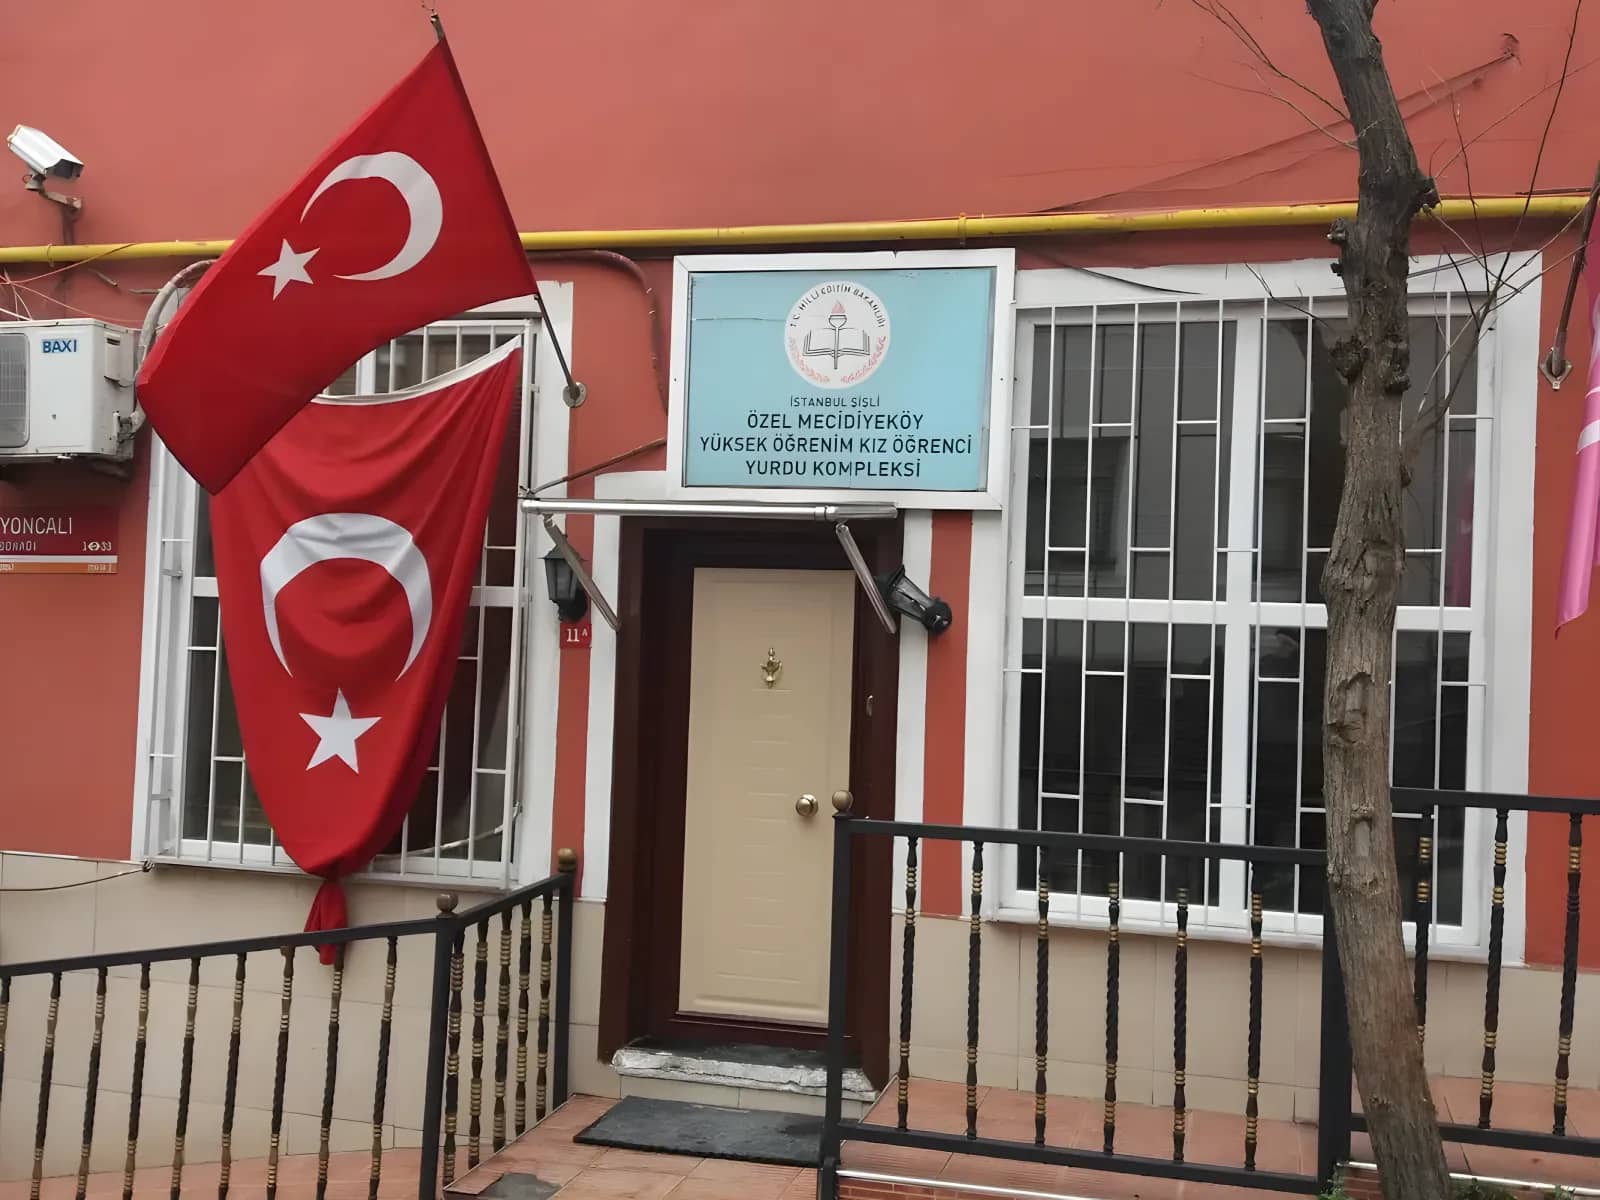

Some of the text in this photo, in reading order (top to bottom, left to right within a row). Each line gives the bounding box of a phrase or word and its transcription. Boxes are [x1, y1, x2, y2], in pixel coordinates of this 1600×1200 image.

[42, 339, 77, 353] BAXI
[790, 396, 848, 408] İSTANBUL
[747, 408, 924, 430] ÖZEL MECİDİYEKÖY
[700, 433, 972, 456] YÜKSEK ÖĞRENİM KIZ ÖĞRENCİ
[745, 457, 922, 478] YURDU KOMPLEKSİ
[0, 516, 72, 535] YONCALI
